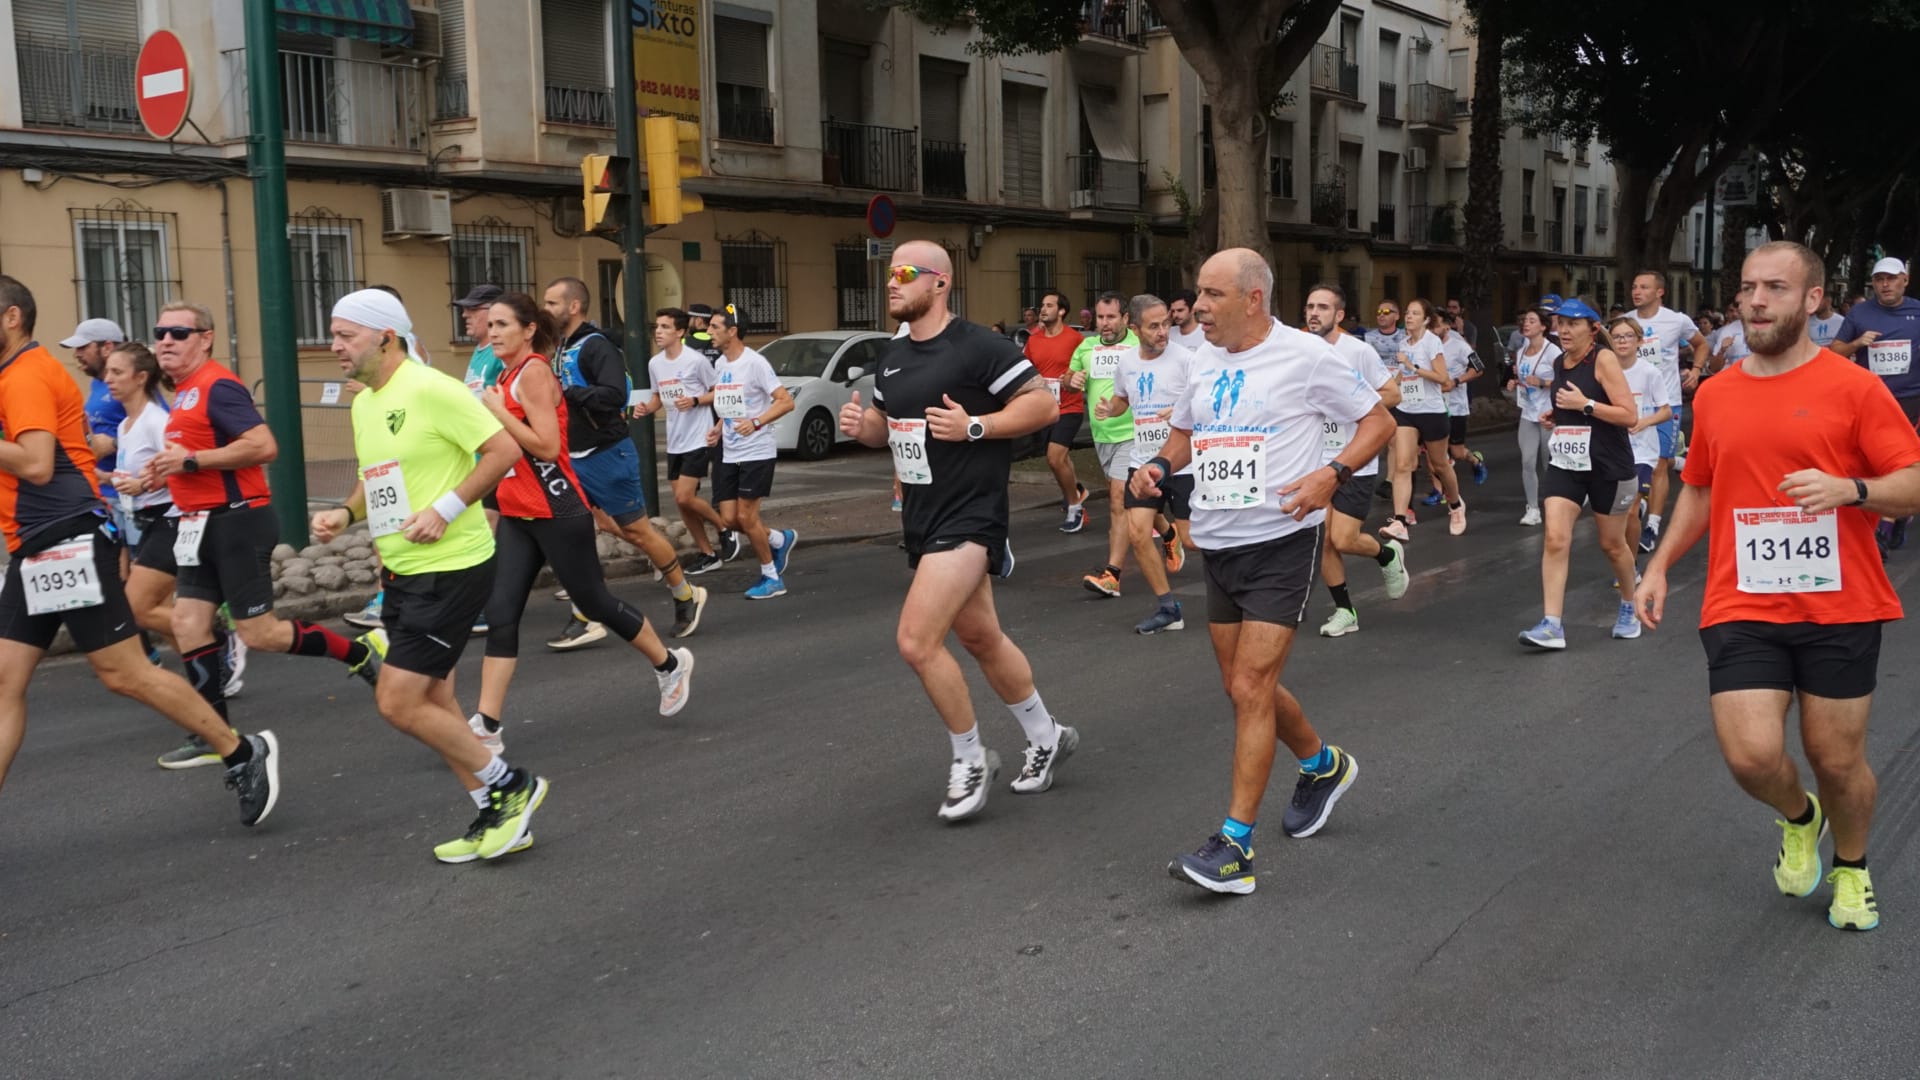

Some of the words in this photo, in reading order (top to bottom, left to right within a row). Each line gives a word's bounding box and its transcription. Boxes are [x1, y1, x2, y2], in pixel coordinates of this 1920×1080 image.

[1873, 352, 1908, 363] 13386
[717, 395, 743, 405] 11704
[1137, 428, 1169, 442] 11966
[1198, 459, 1256, 482] 13841
[1736, 512, 1761, 526] 42
[1746, 535, 1831, 561] 13148
[30, 567, 89, 594] 13931
[1219, 861, 1240, 878] HOKA
